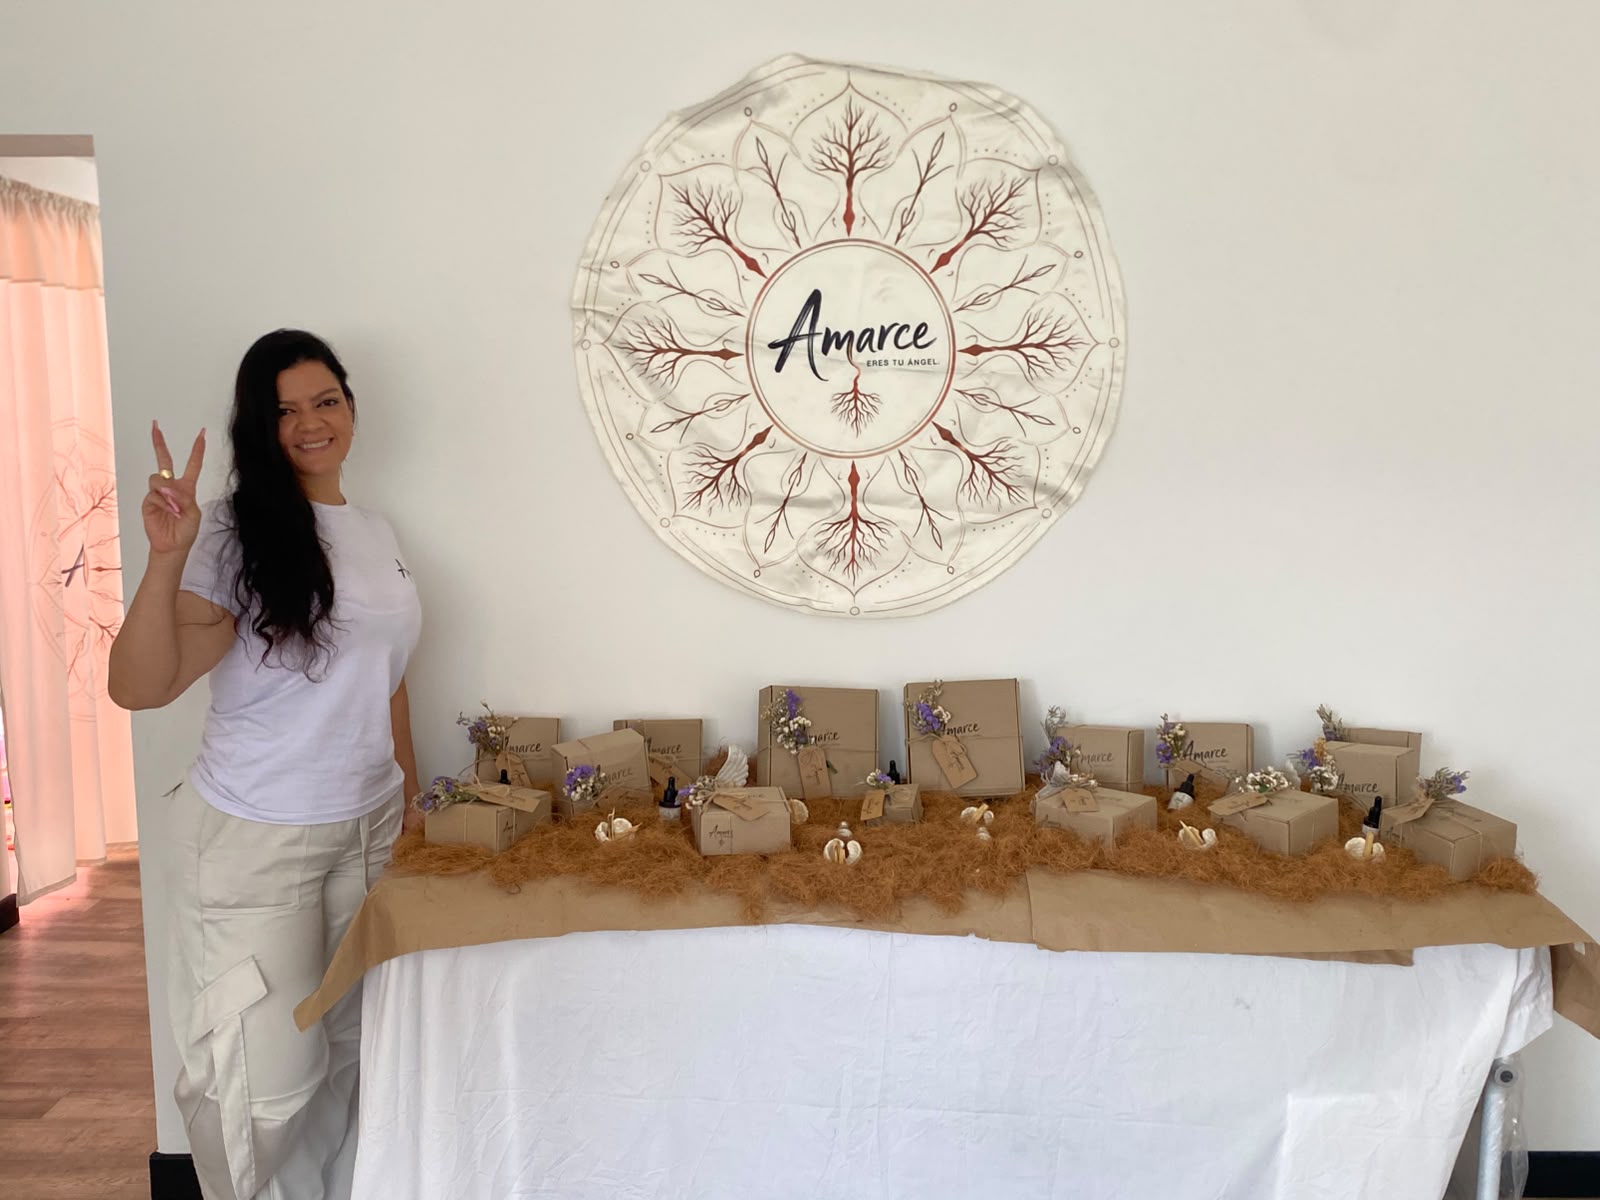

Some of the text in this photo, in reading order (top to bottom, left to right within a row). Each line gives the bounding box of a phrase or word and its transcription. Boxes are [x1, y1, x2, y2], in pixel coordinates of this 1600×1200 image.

[767, 288, 938, 382] Amarce
[866, 359, 890, 367] ERES
[1182, 740, 1229, 764] Amarce
